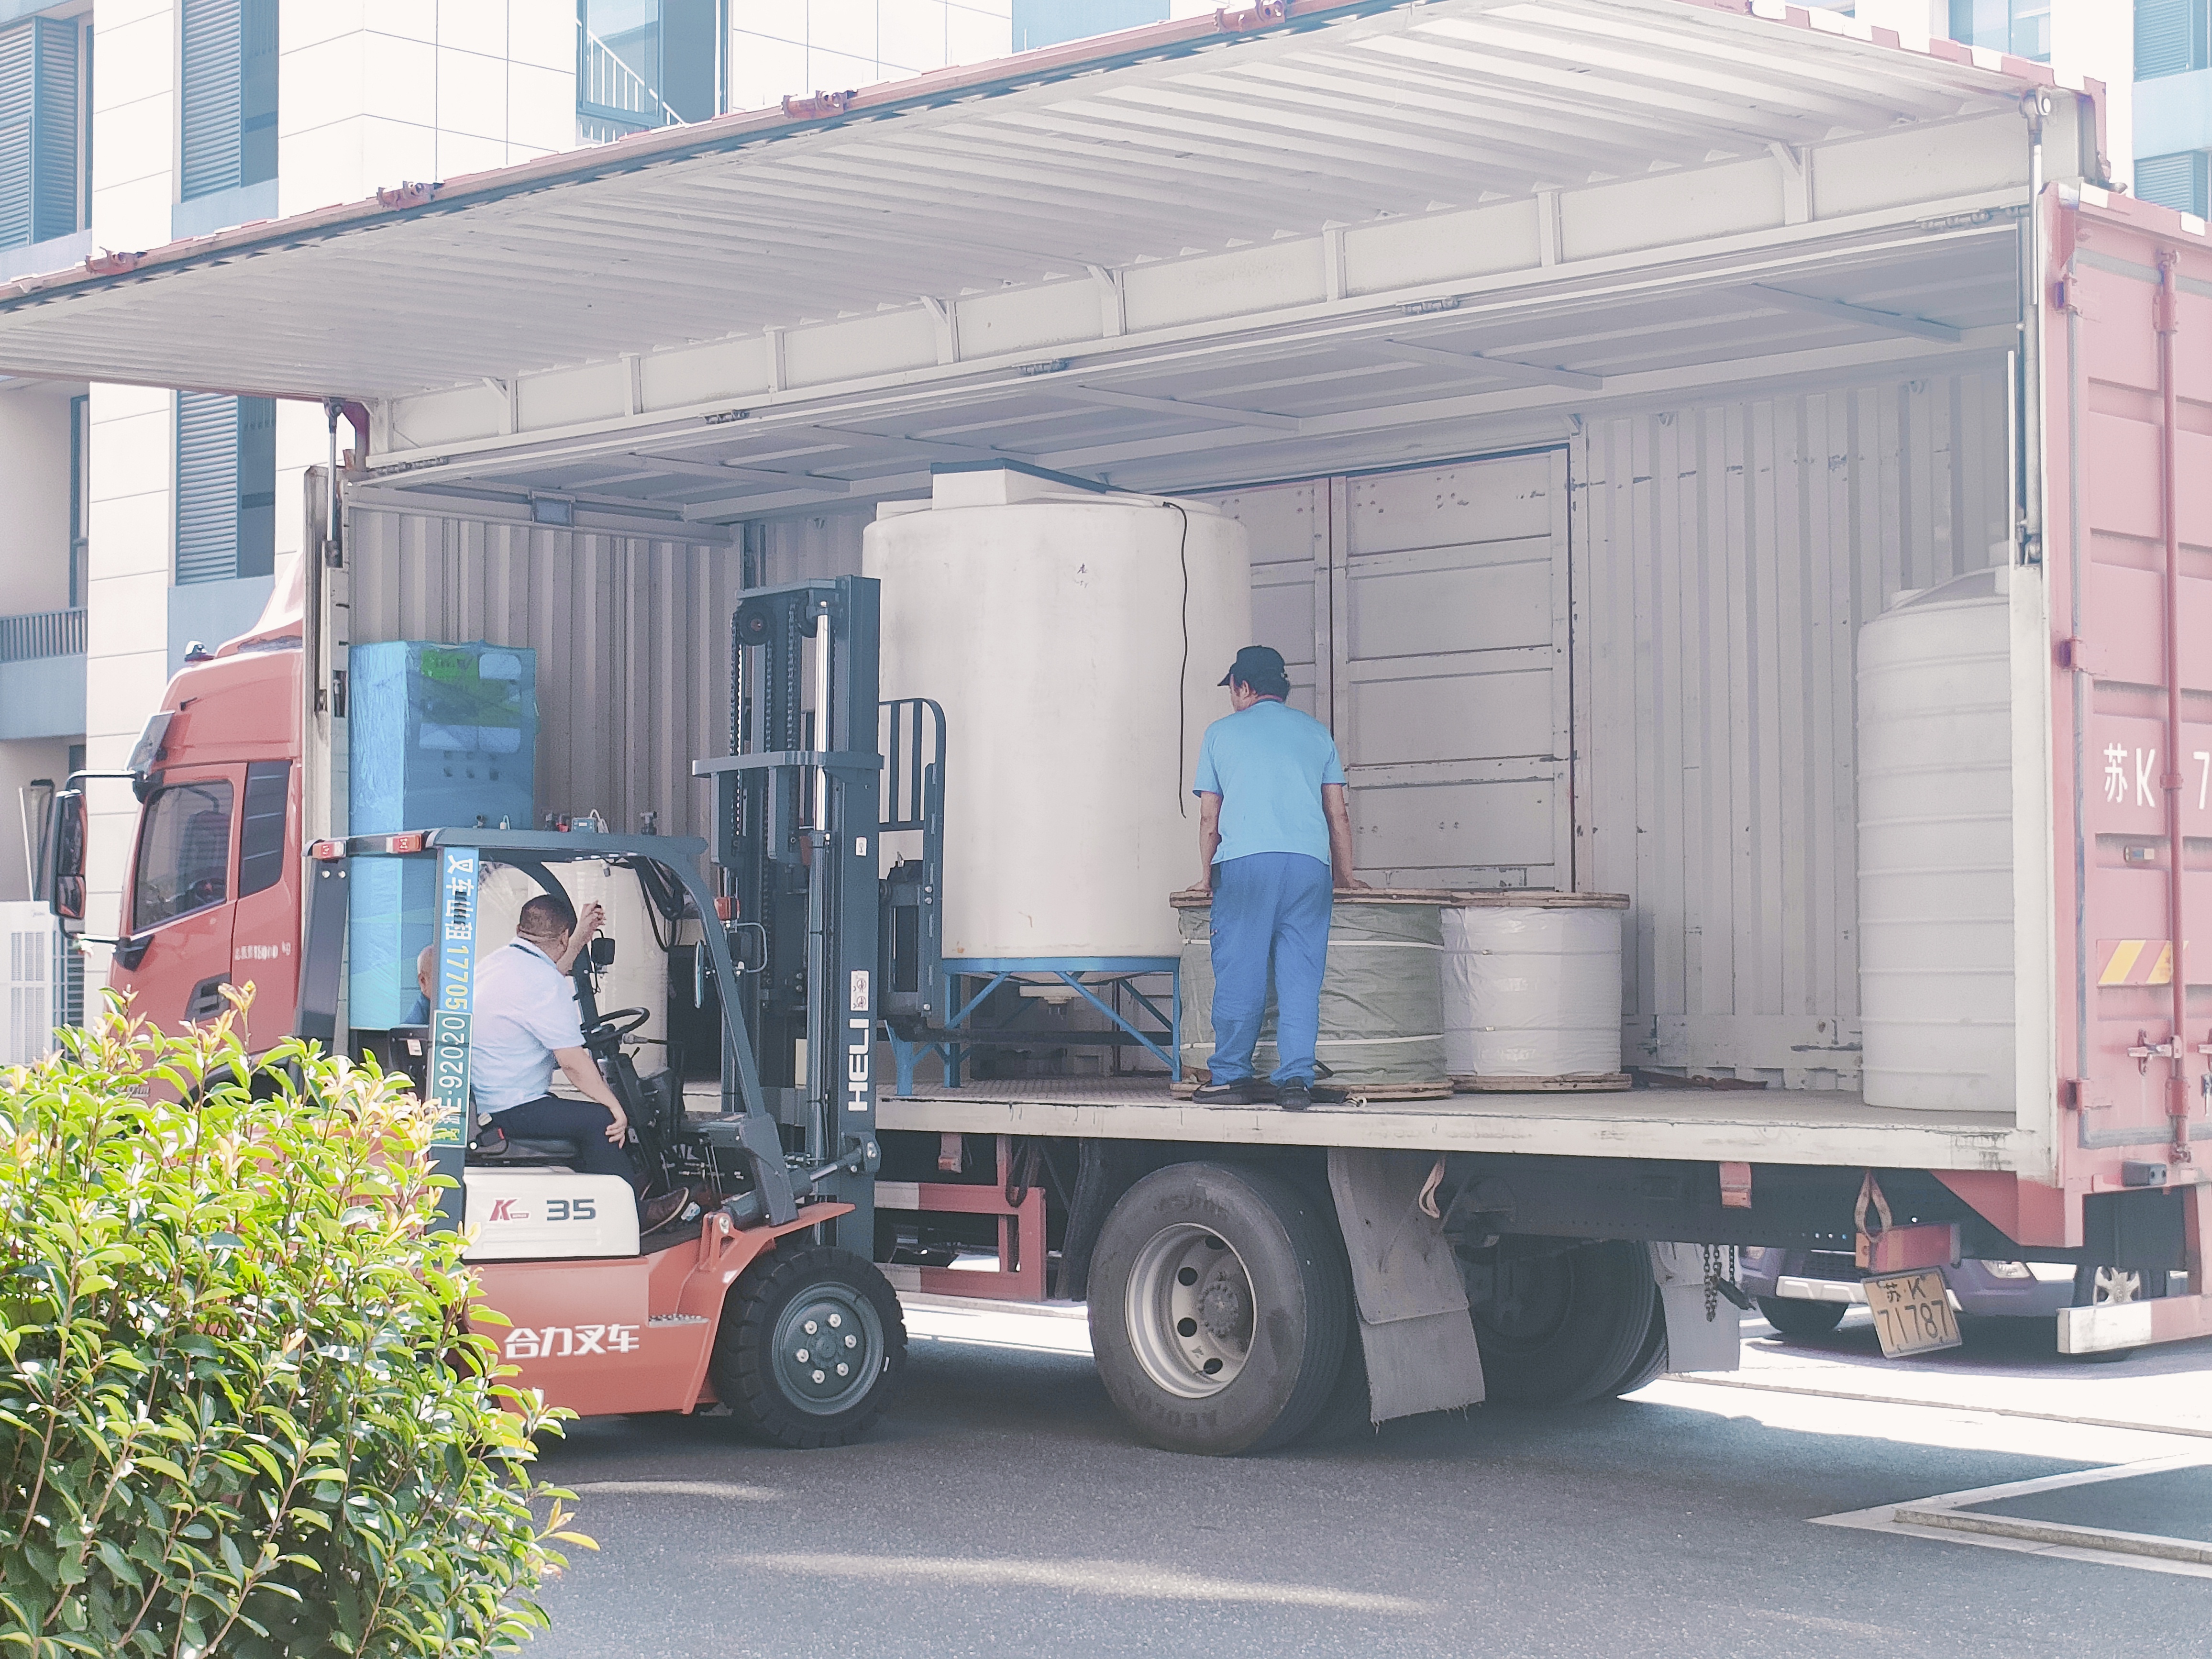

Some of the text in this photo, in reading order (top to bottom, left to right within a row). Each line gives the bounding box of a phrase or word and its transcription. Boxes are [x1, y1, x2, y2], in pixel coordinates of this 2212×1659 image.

[2103, 742, 2156, 807] 苏K
[848, 1018, 870, 1112] HELI
[546, 1198, 597, 1221] 35
[504, 1323, 640, 1360] 合力叉车
[1877, 1300, 1948, 1347] 71787
